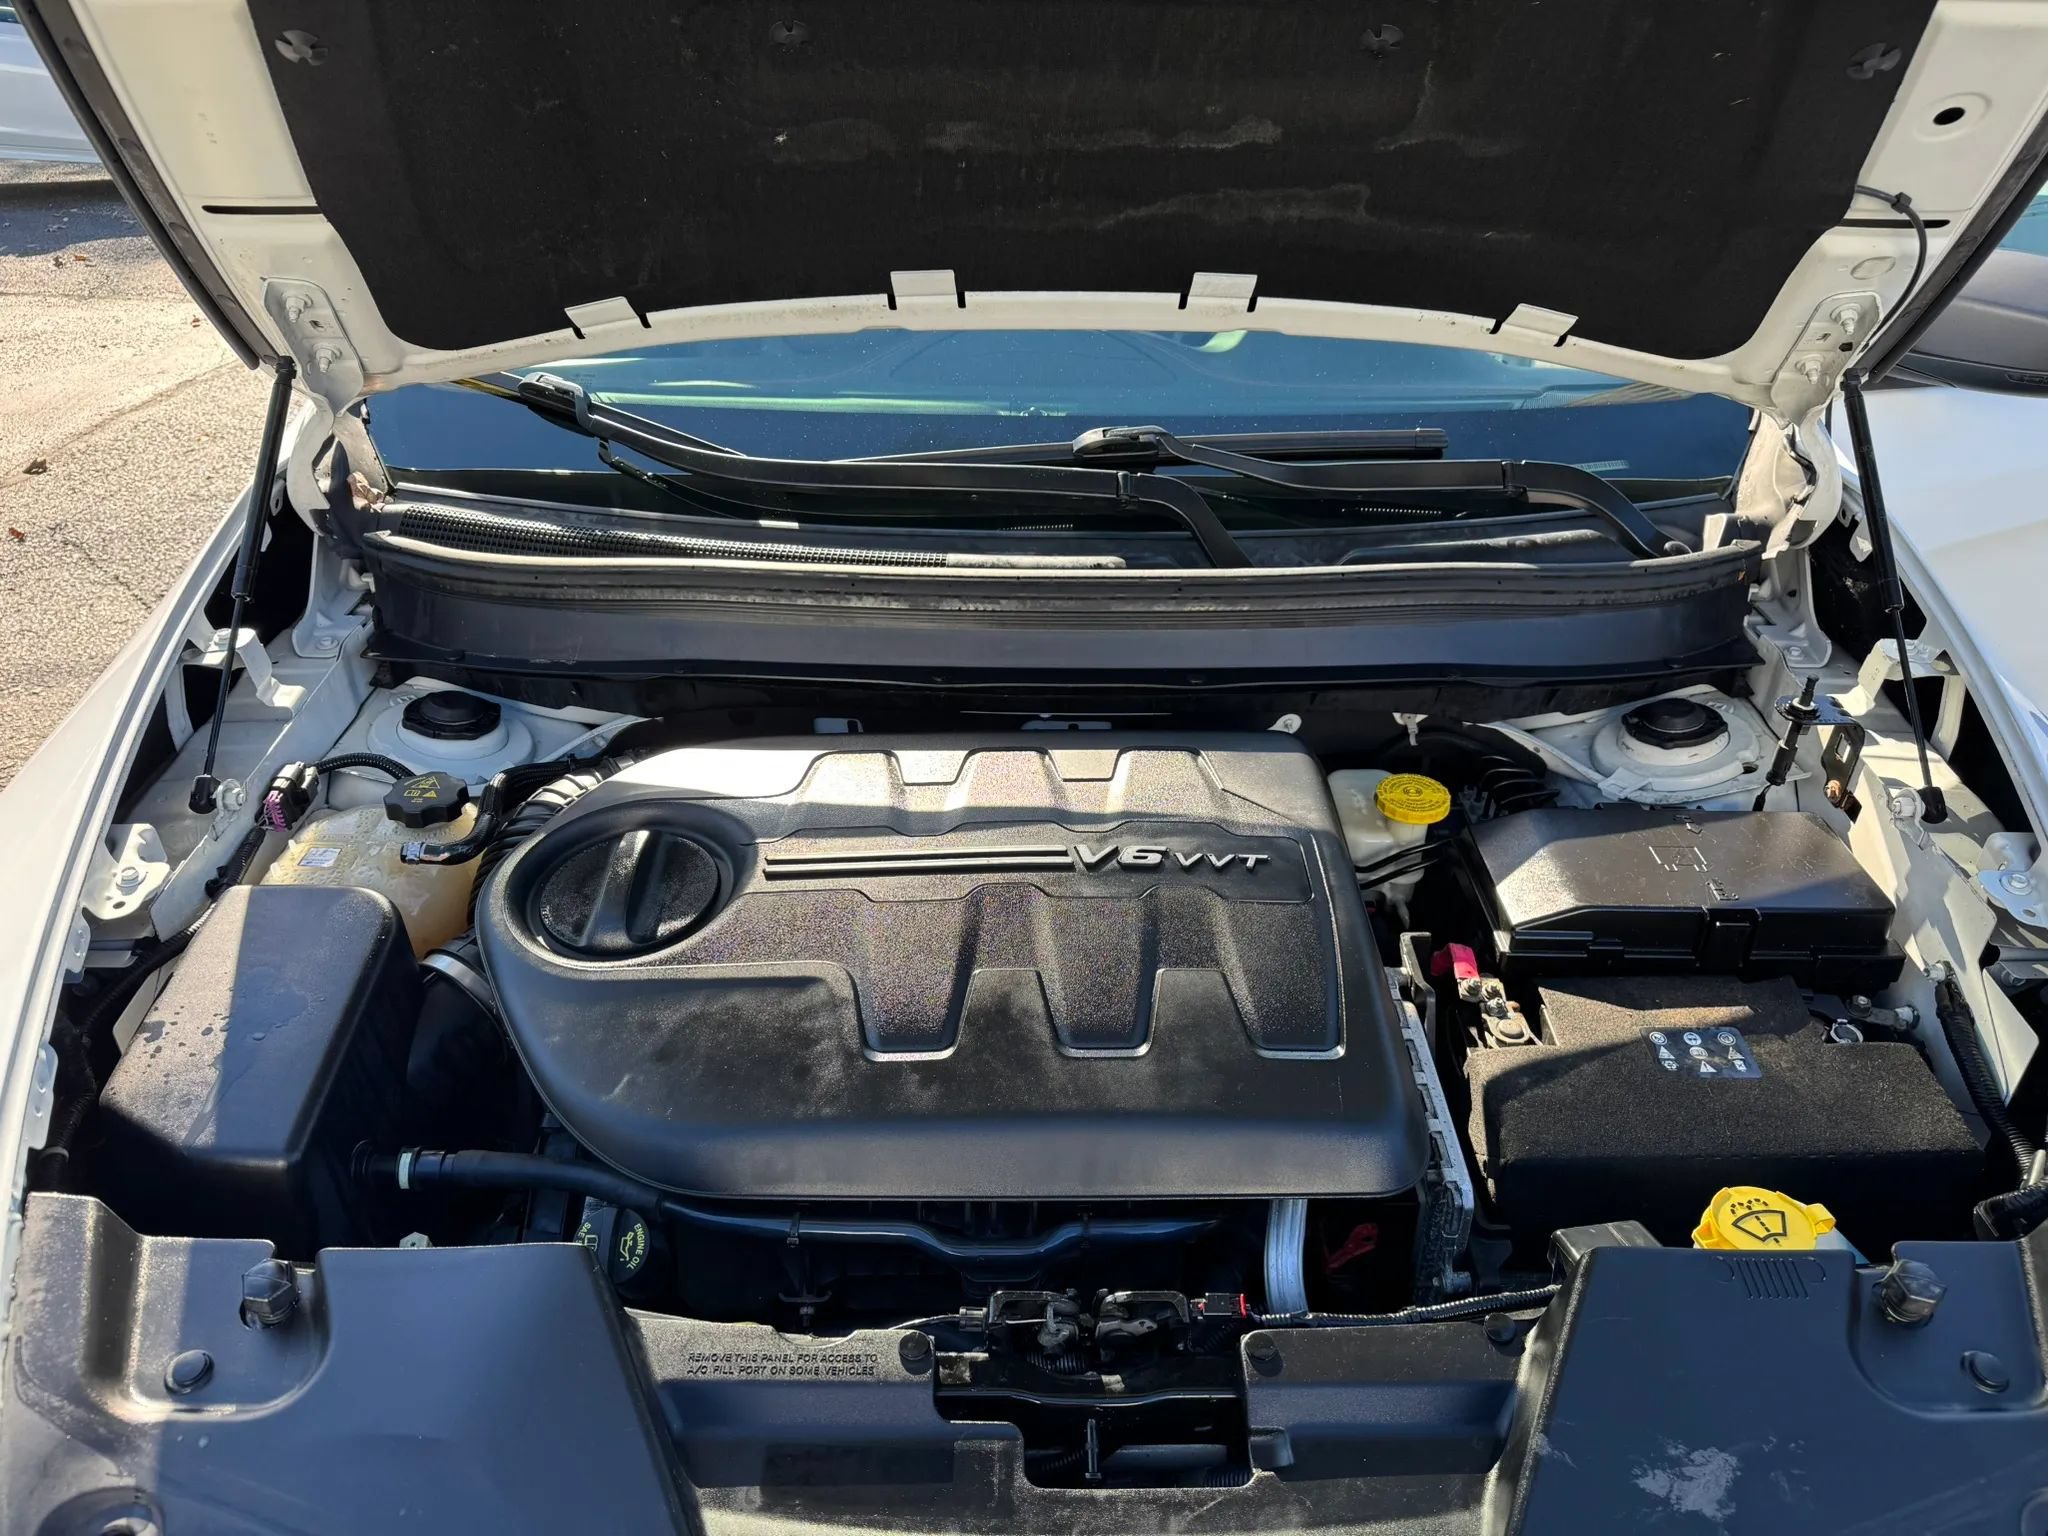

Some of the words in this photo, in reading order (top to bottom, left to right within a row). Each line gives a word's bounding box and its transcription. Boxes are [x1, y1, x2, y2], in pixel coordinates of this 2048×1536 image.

[1074, 844, 1168, 872] V6
[1173, 851, 1270, 870] VVT
[578, 1222, 591, 1238] SAE
[634, 1223, 645, 1255] ENGINE
[626, 1256, 640, 1270] OIL
[688, 1353, 733, 1363] REMOVE
[735, 1353, 758, 1363] THIS
[761, 1353, 794, 1363] PANEL
[798, 1353, 817, 1363] FOR
[820, 1354, 861, 1363] ACCESS
[864, 1353, 878, 1363] TO
[713, 1365, 734, 1375] FILL
[739, 1365, 767, 1375] PORT
[770, 1365, 787, 1375] ON
[789, 1365, 820, 1375] SOME
[824, 1366, 875, 1375] VEHICLES
